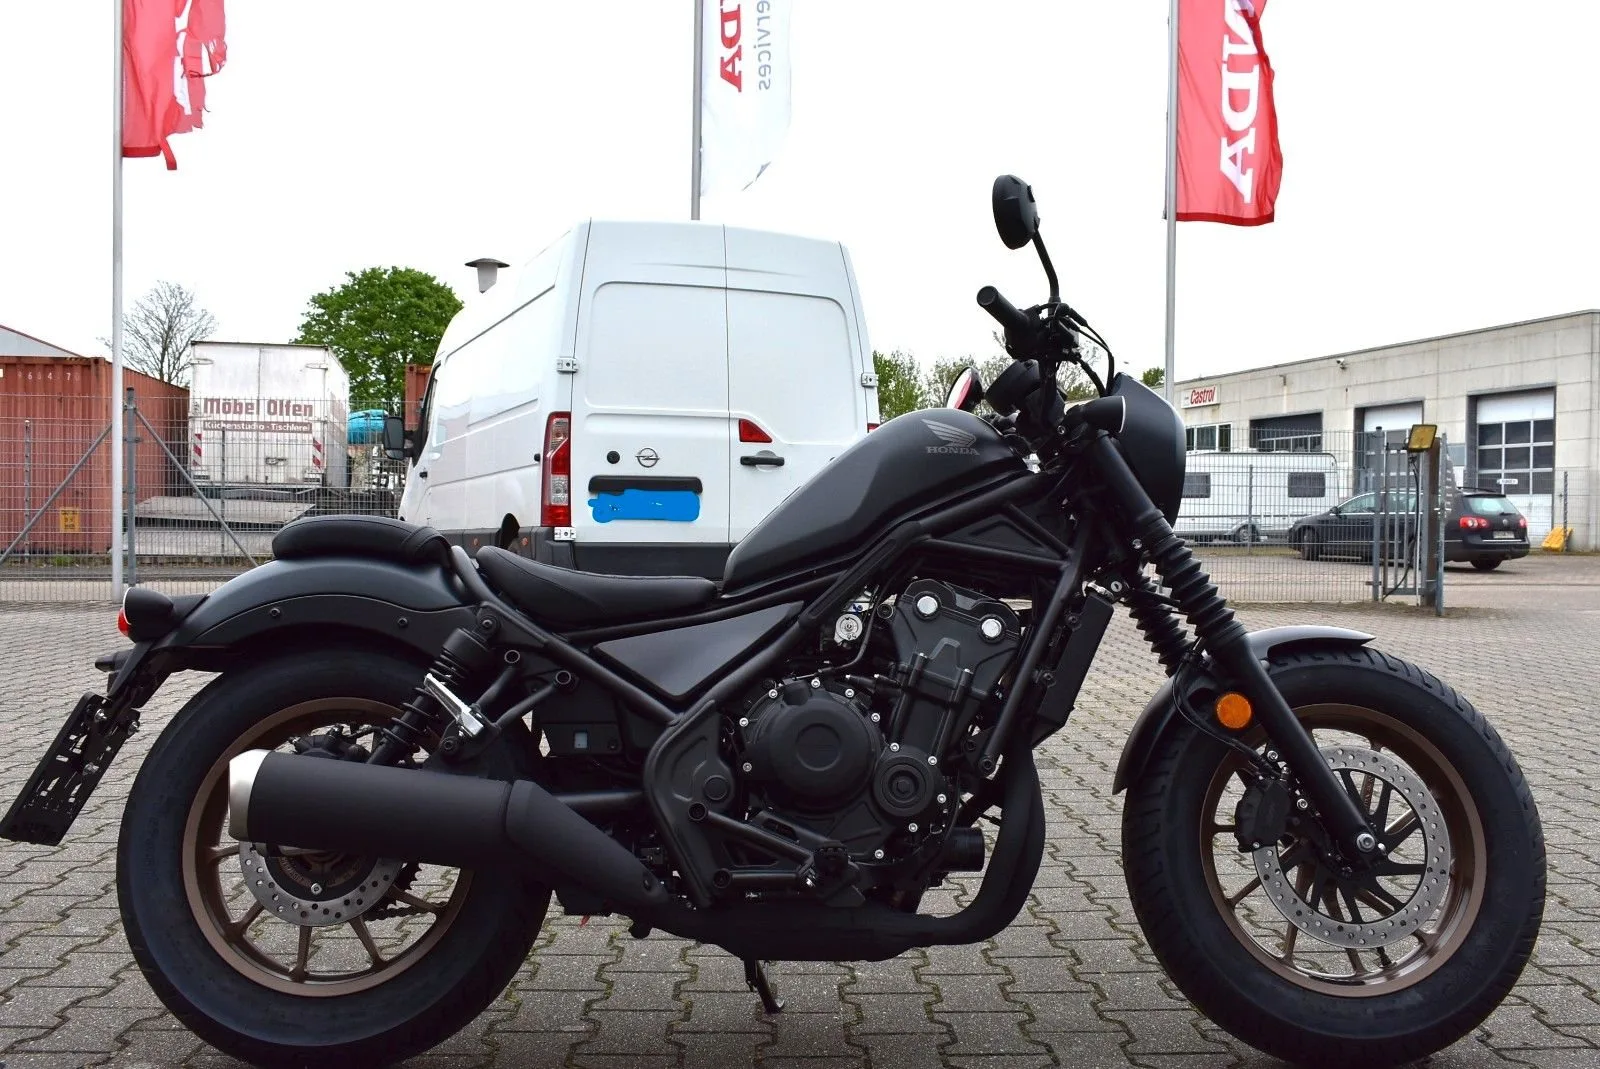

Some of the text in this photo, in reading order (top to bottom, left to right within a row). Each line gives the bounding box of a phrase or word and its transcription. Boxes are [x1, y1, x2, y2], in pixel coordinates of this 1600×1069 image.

[1190, 386, 1216, 405] Castrol
[203, 398, 260, 416] Möbel
[266, 400, 313, 417] Olfen
[271, 423, 311, 432] Tischlerei
[926, 446, 981, 456] HONDA
